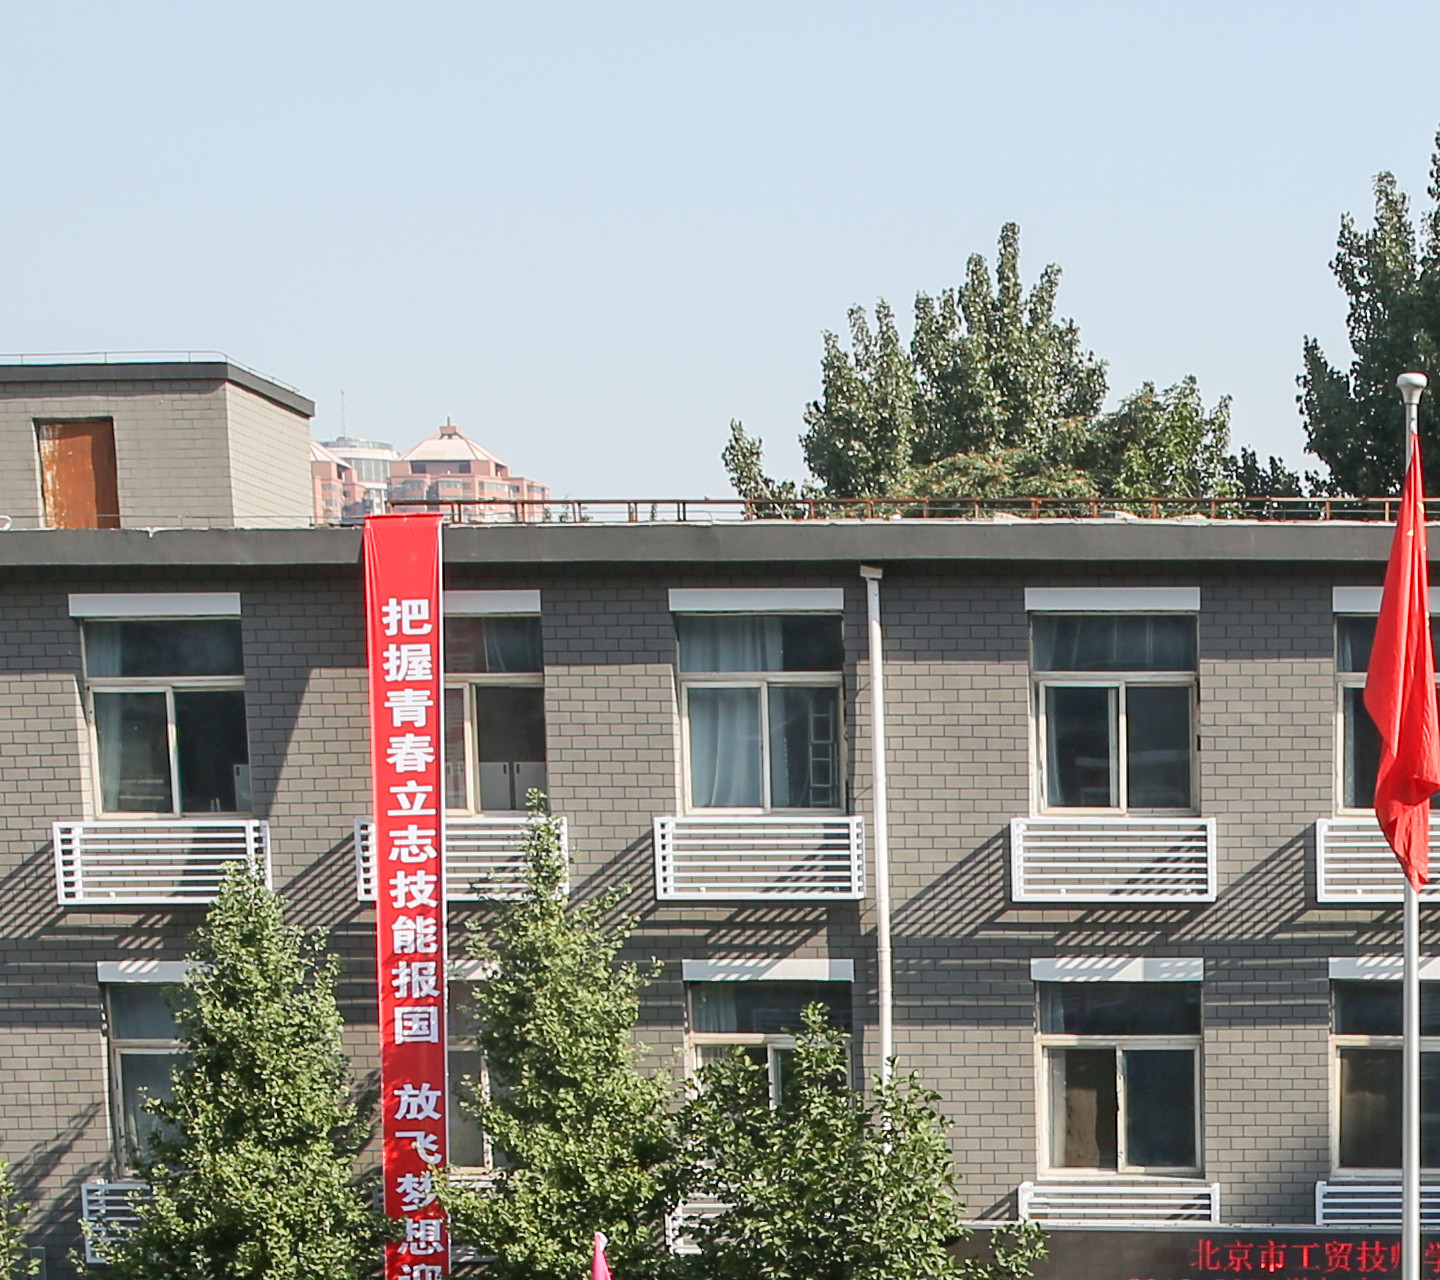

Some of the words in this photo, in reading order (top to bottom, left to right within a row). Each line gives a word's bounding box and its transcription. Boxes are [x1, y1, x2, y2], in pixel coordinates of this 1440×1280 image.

[380, 597, 441, 1045] 把握青春立志技能报国
